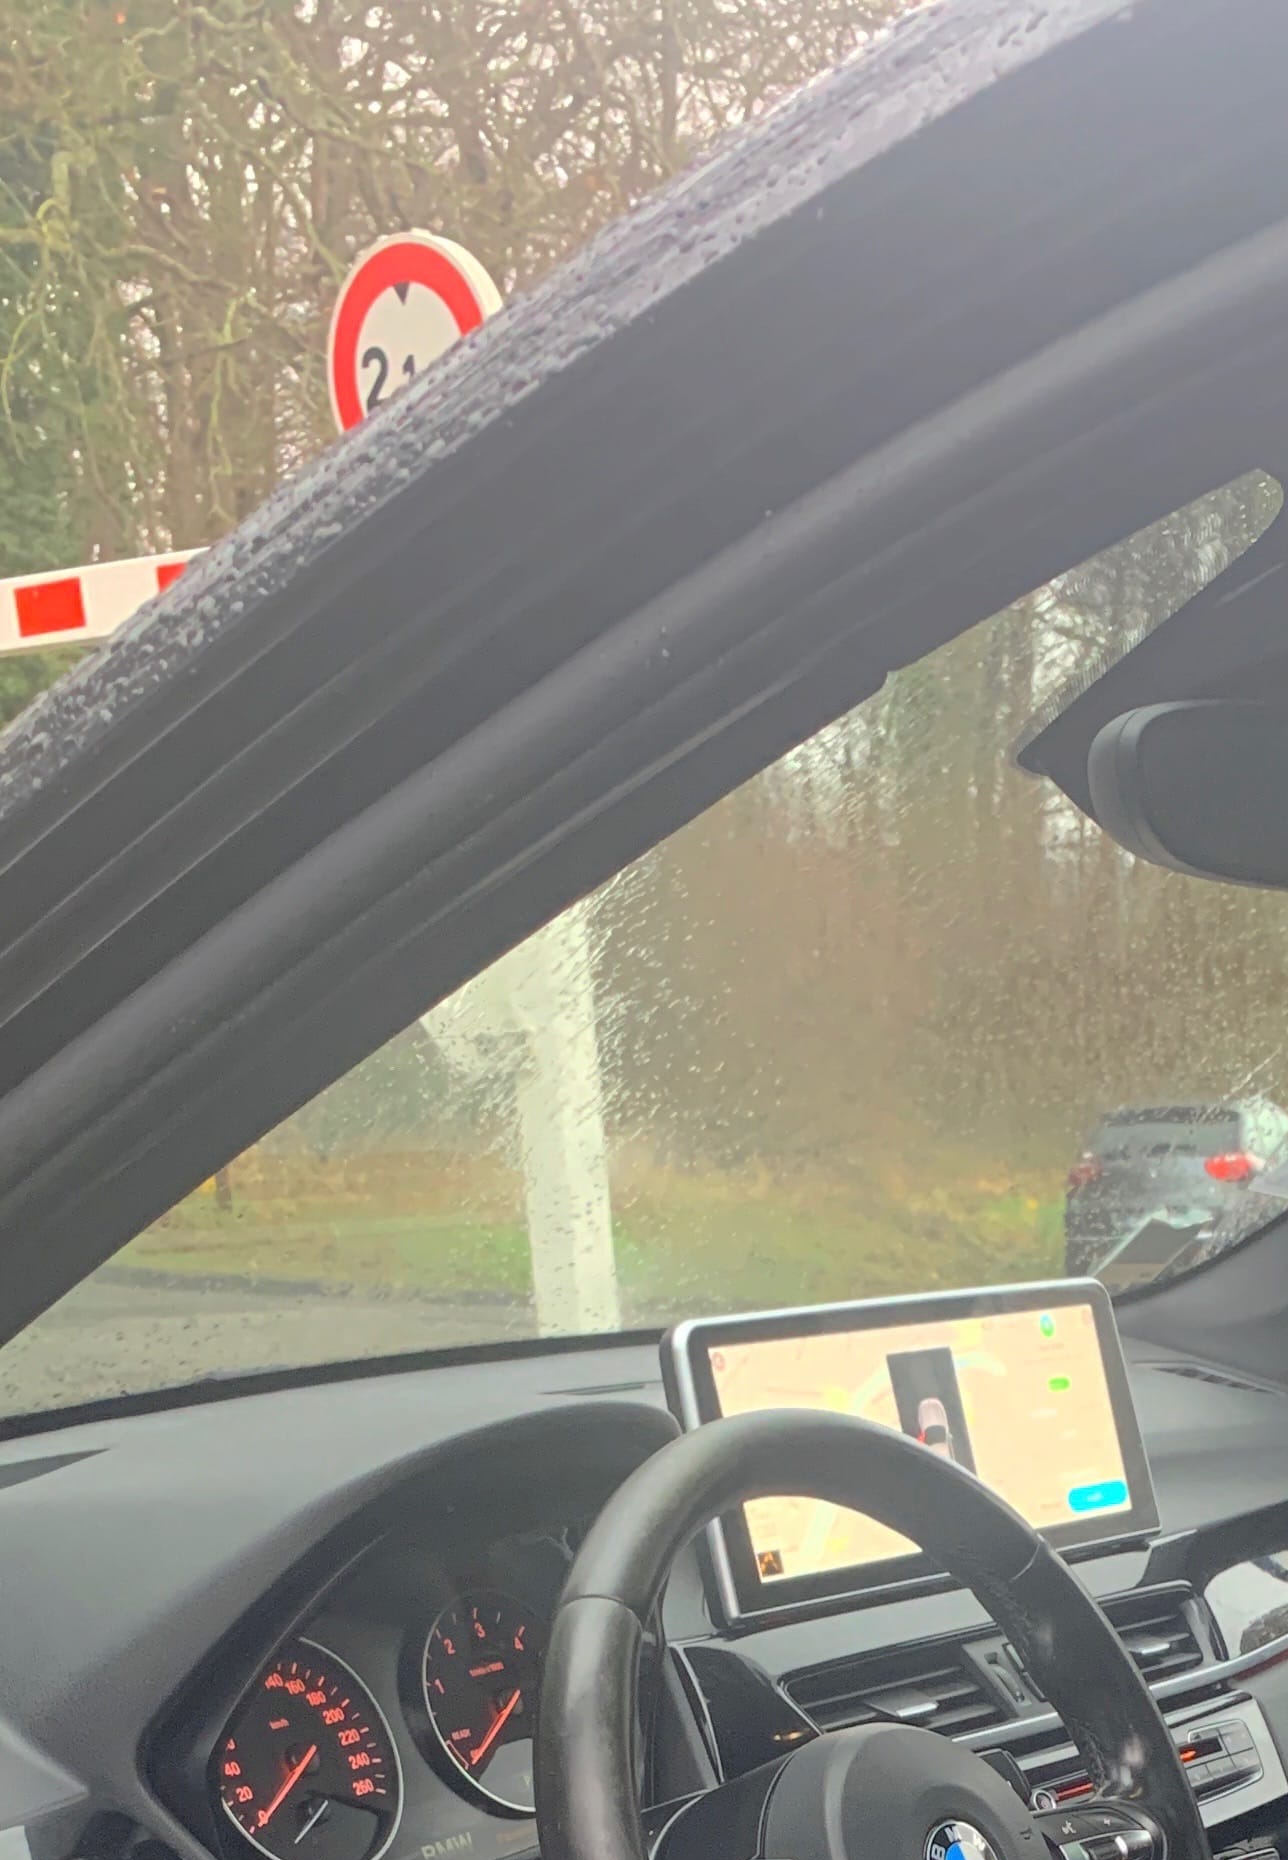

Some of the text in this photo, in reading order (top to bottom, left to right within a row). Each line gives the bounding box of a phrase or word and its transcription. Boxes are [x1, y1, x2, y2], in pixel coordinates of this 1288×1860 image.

[474, 1622, 486, 1638] 3
[443, 1638, 456, 1655] 2
[514, 1636, 525, 1651] 4
[434, 1678, 445, 1694] 1
[323, 1707, 345, 1725] 200
[338, 1728, 360, 1746] 220
[224, 1761, 241, 1776] 40
[348, 1752, 370, 1770] 240
[235, 1785, 253, 1802] 20
[352, 1778, 374, 1796] 260
